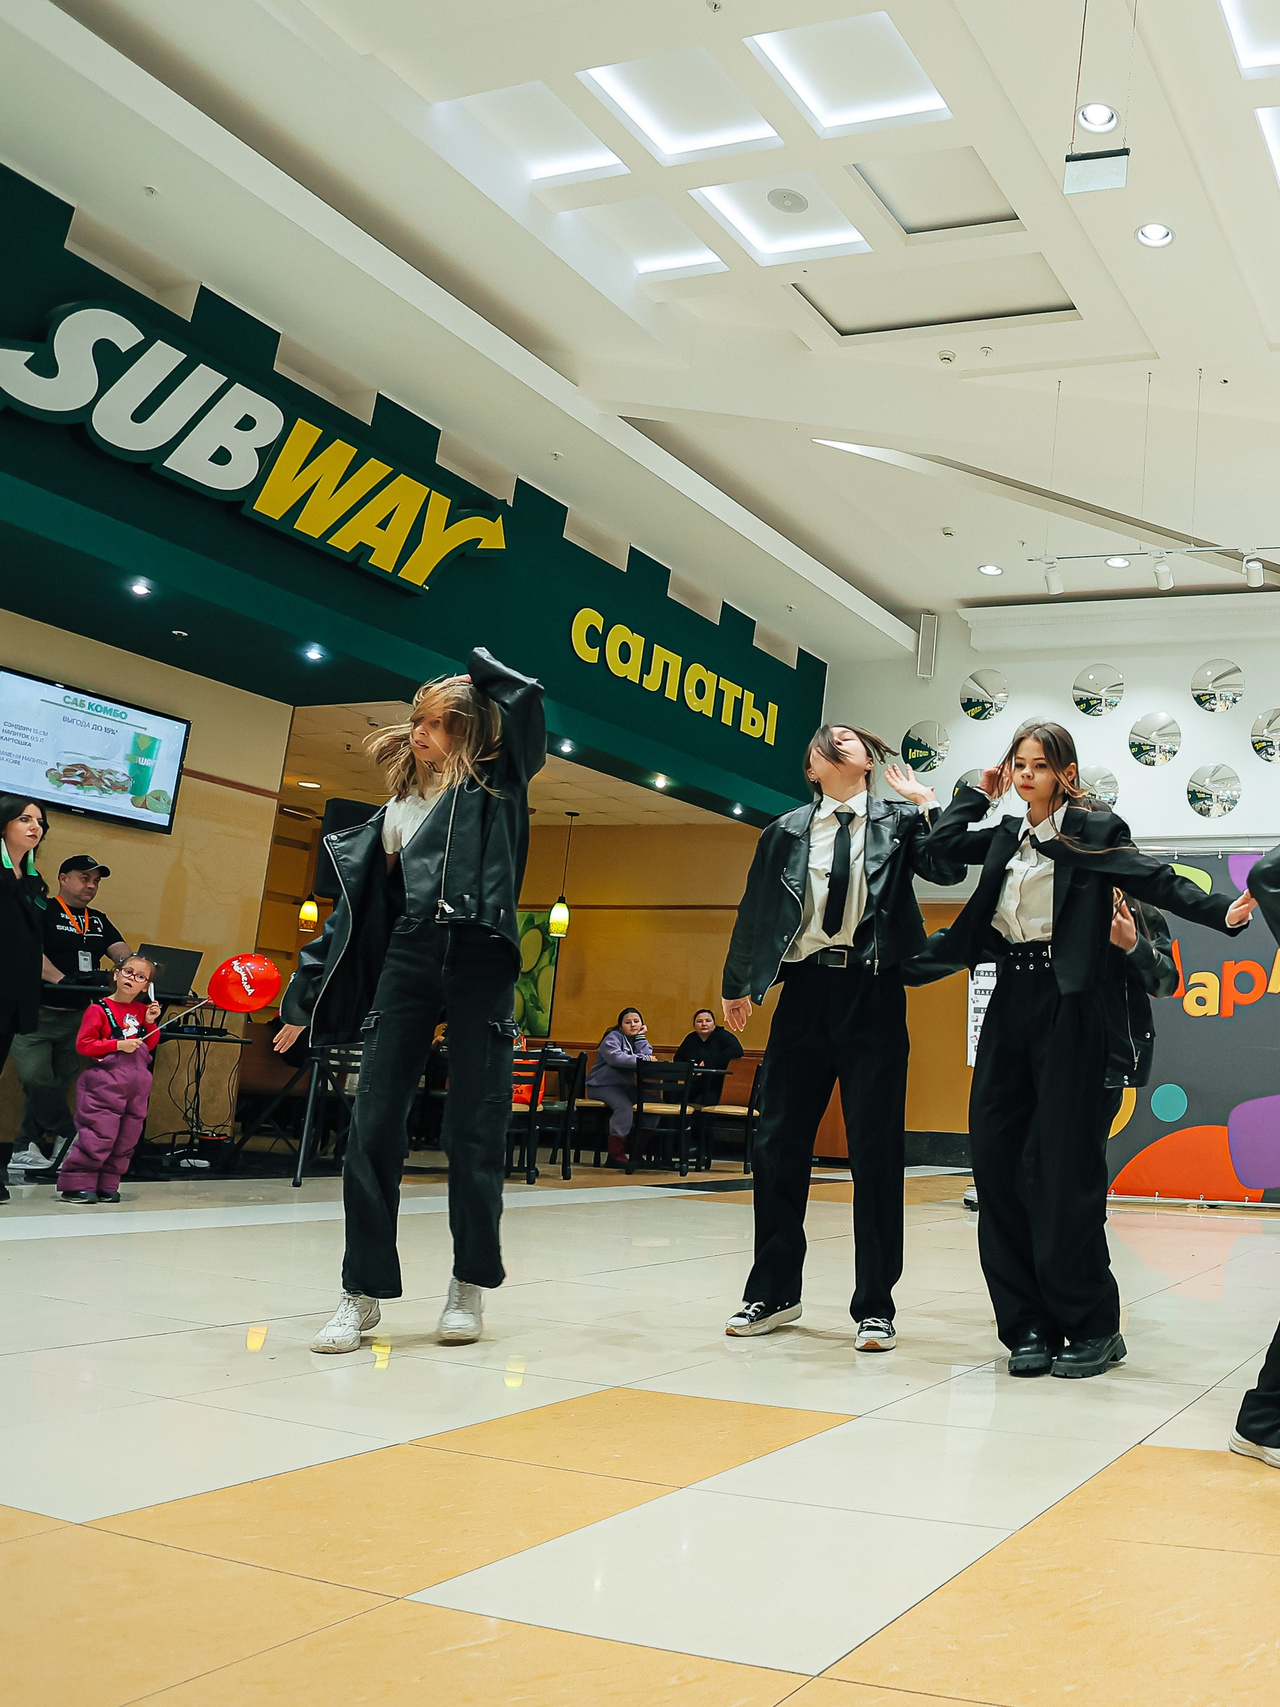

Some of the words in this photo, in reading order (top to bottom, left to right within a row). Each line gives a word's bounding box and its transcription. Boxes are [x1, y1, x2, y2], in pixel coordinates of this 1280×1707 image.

[0, 308, 506, 587] SUBWAY
[62, 695, 86, 708] САБ
[87, 701, 128, 720] КОМБО
[571, 607, 778, 746] салаты
[62, 715, 90, 728] ВЫГОДА
[91, 723, 103, 732] ДО
